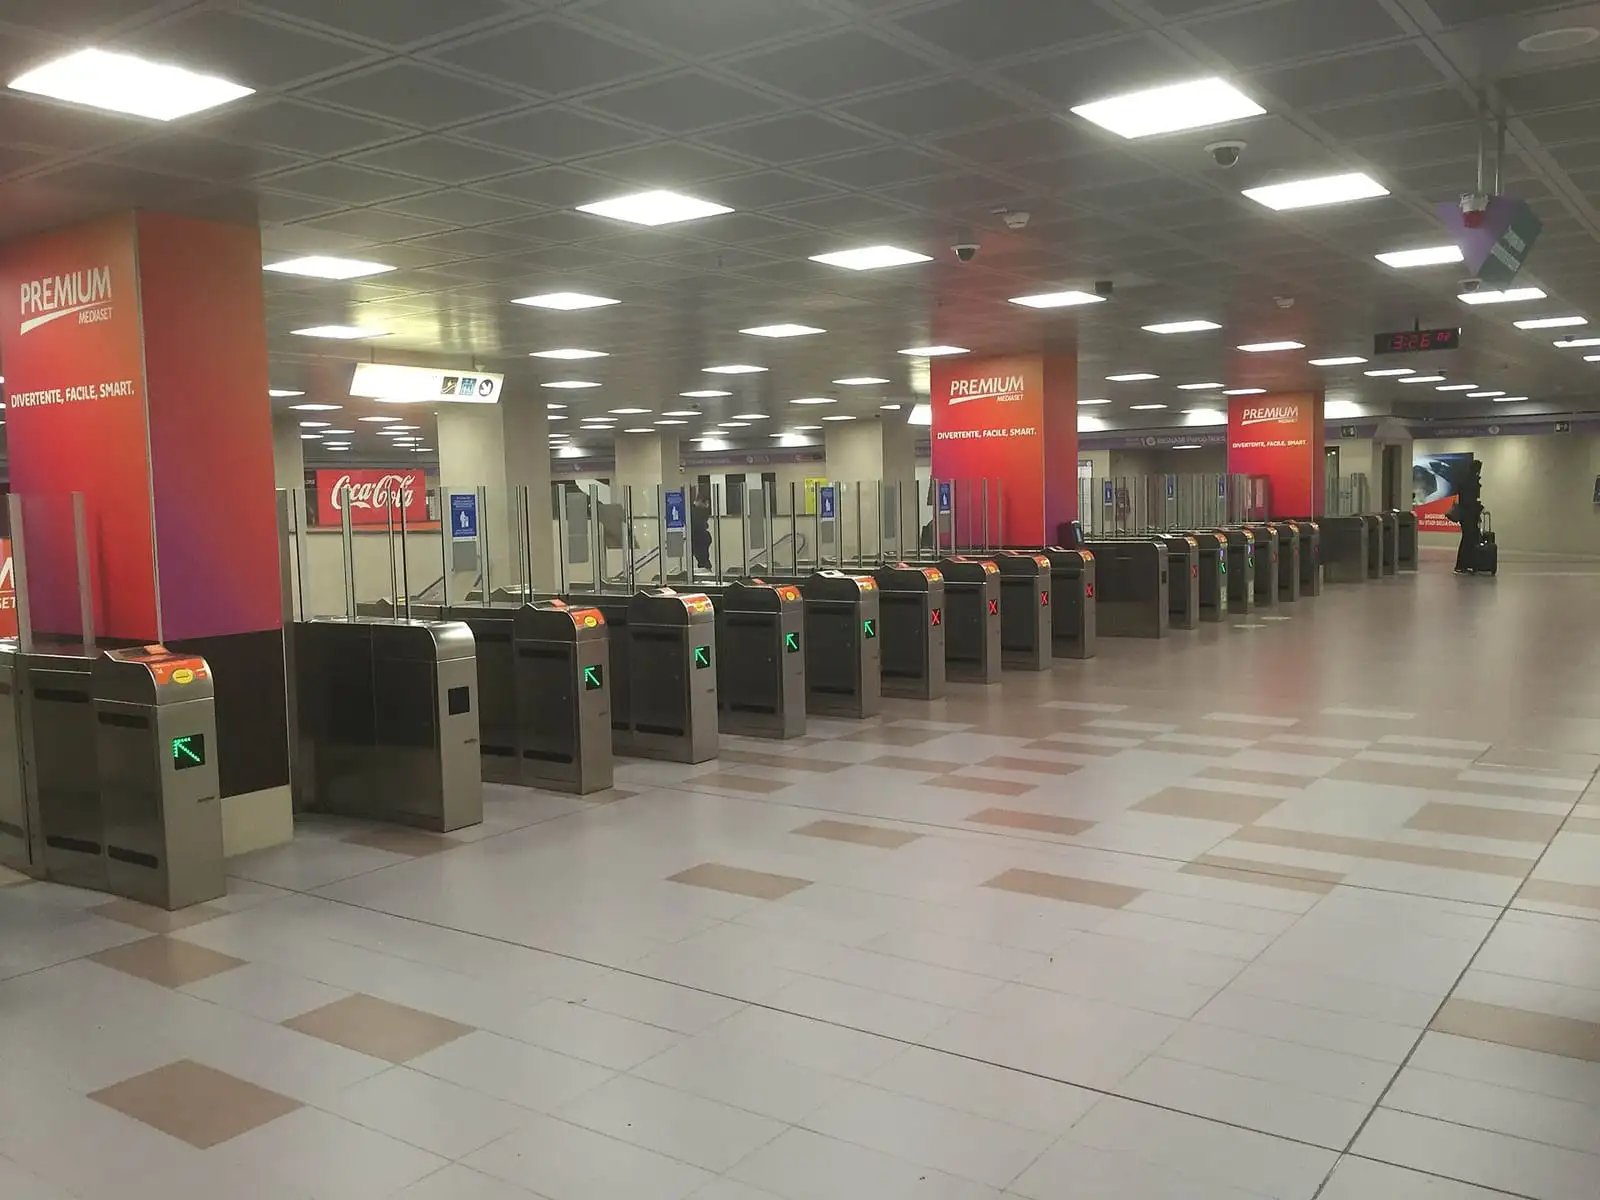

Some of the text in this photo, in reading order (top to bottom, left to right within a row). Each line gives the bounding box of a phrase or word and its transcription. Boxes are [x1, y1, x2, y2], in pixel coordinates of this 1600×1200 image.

[20, 265, 112, 315] PREMIUM
[78, 306, 113, 325] MEDIASET
[11, 380, 135, 408] DIVERTENTE, FACILE, SMART.
[950, 376, 1024, 396] PREMIUM
[1242, 406, 1299, 420] PREMIUM
[1009, 426, 1036, 436] SMART.
